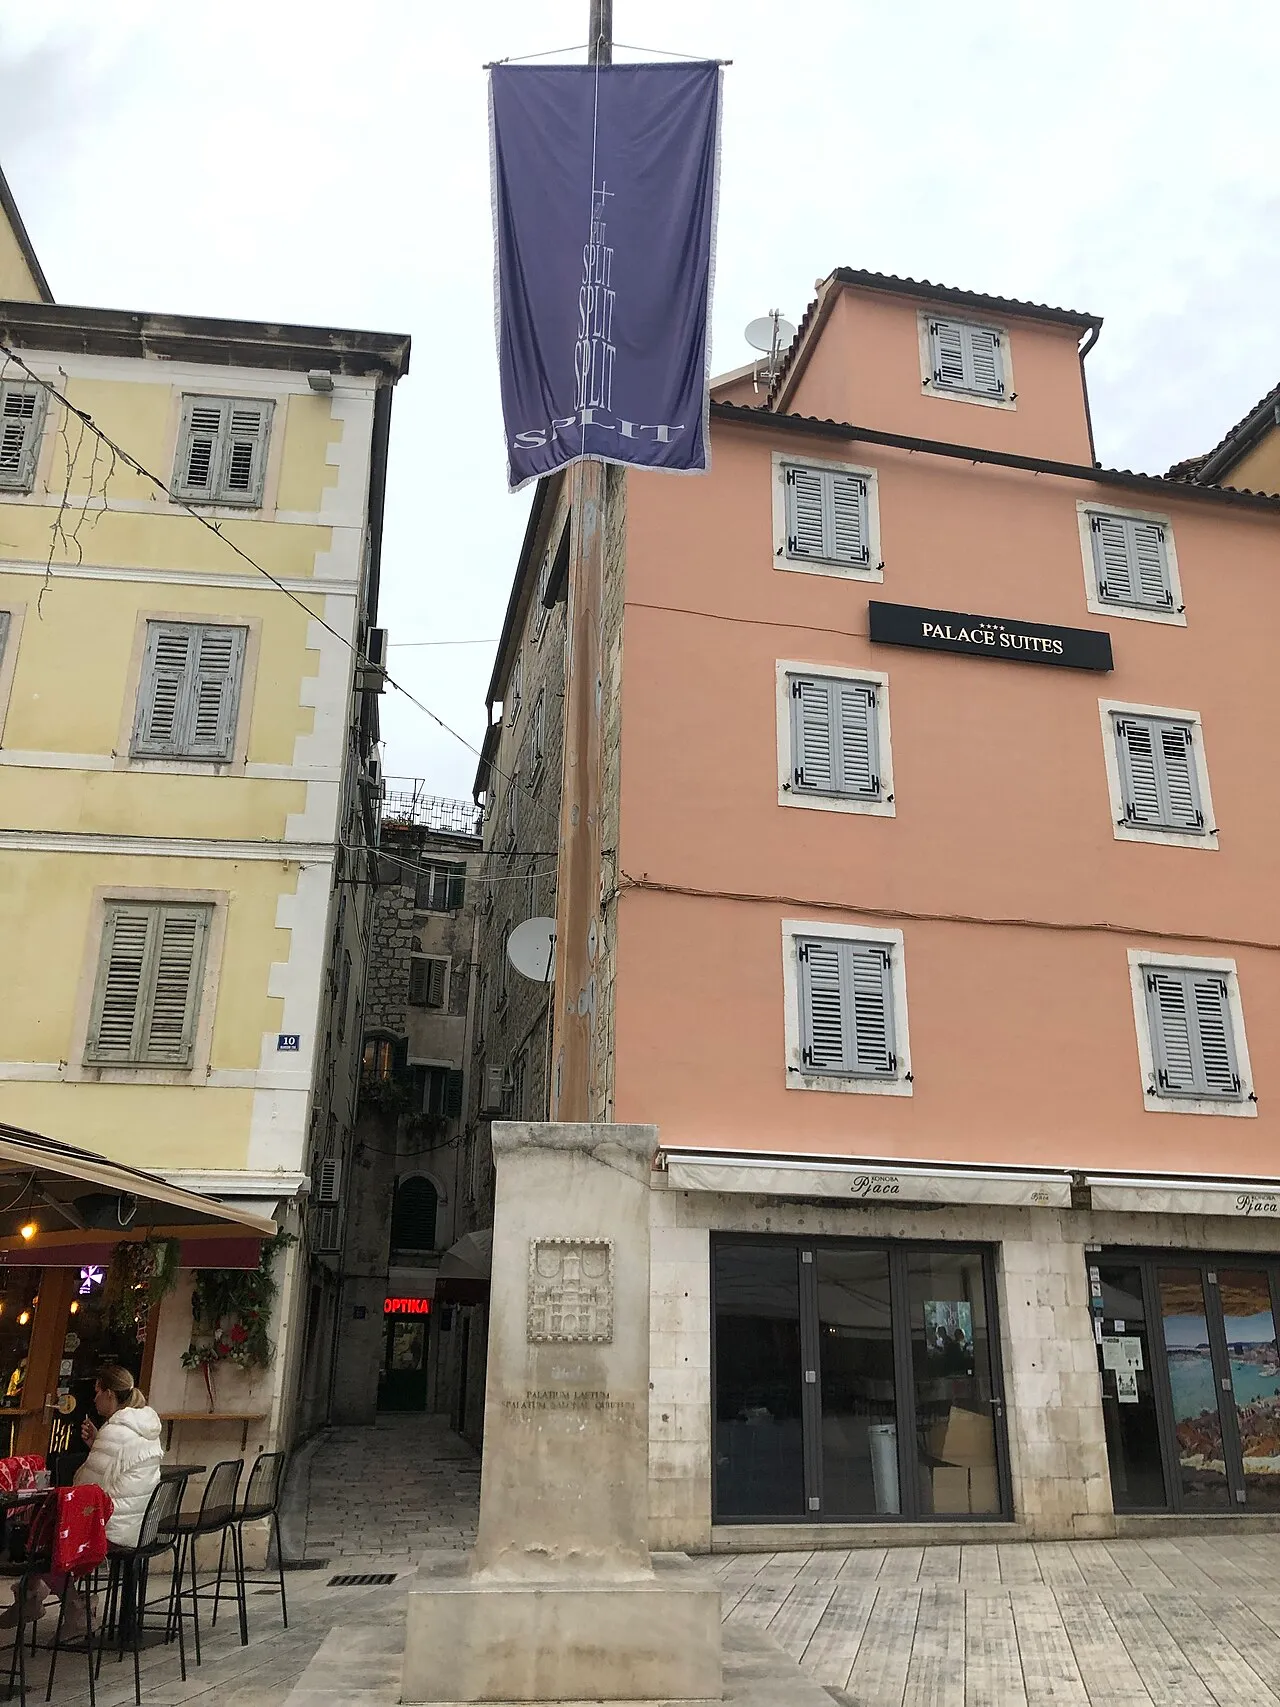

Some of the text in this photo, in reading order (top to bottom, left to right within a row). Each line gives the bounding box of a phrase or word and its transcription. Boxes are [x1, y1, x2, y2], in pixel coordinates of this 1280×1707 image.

[582, 244, 614, 288] SPLIT
[578, 285, 616, 342] SPLIT
[573, 339, 616, 412] SPLIT
[513, 408, 685, 449] SPLIT
[921, 622, 1064, 655] PALACE SUITES
[283, 1036, 296, 1046] 10
[850, 1175, 900, 1197] Pjaca
[1235, 1195, 1278, 1216] Pjaca
[383, 1298, 429, 1313] OPTIKA
